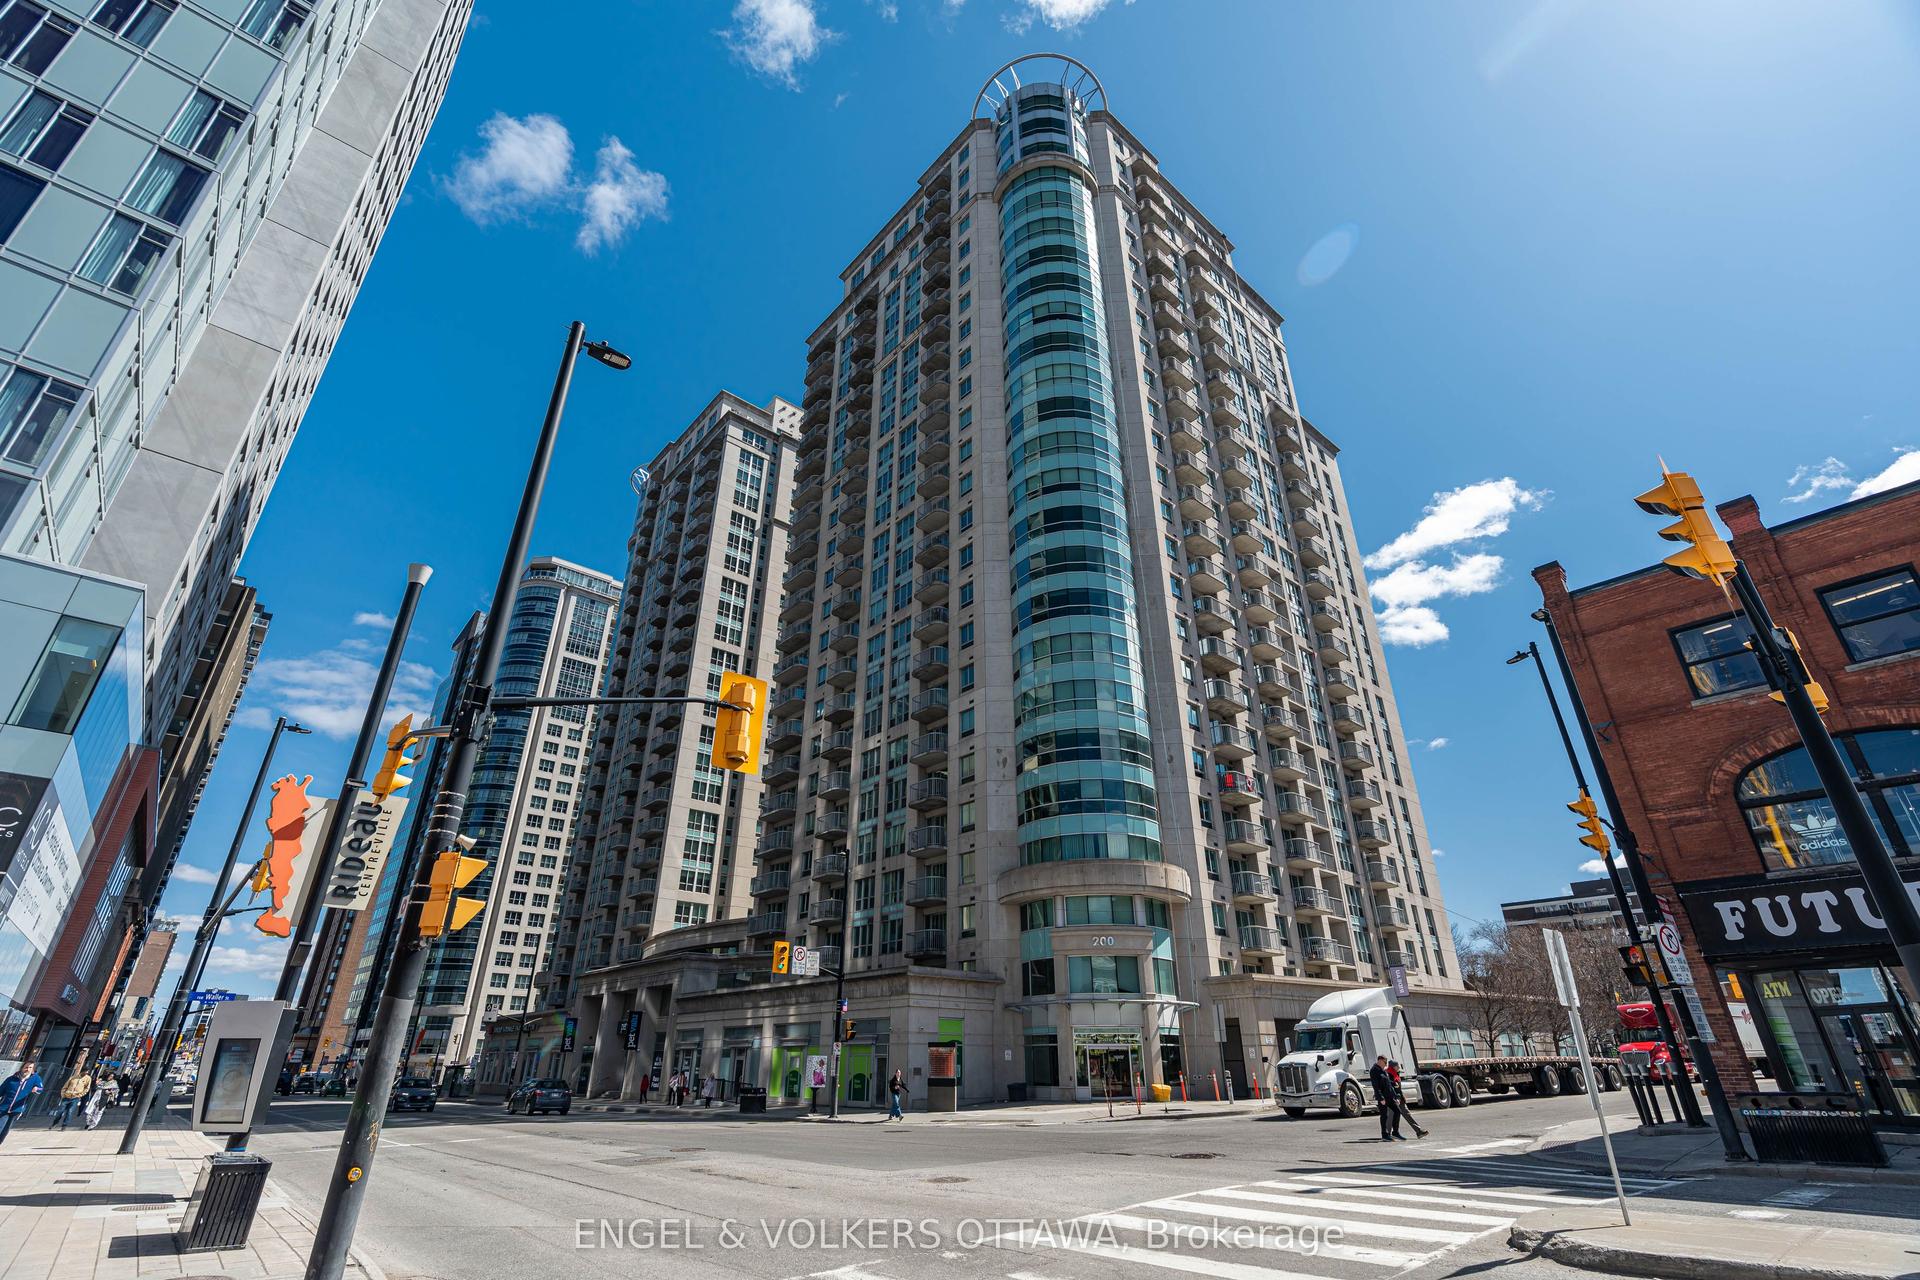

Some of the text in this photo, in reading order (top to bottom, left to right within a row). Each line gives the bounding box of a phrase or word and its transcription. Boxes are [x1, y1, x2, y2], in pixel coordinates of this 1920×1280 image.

[1799, 836, 1848, 851] adidas
[358, 808, 392, 897] CENTRE-VILLE
[1714, 882, 1920, 941] FUTU
[1091, 936, 1114, 946] 200
[1762, 980, 1792, 999] ATM
[627, 1032, 636, 1048] pet
